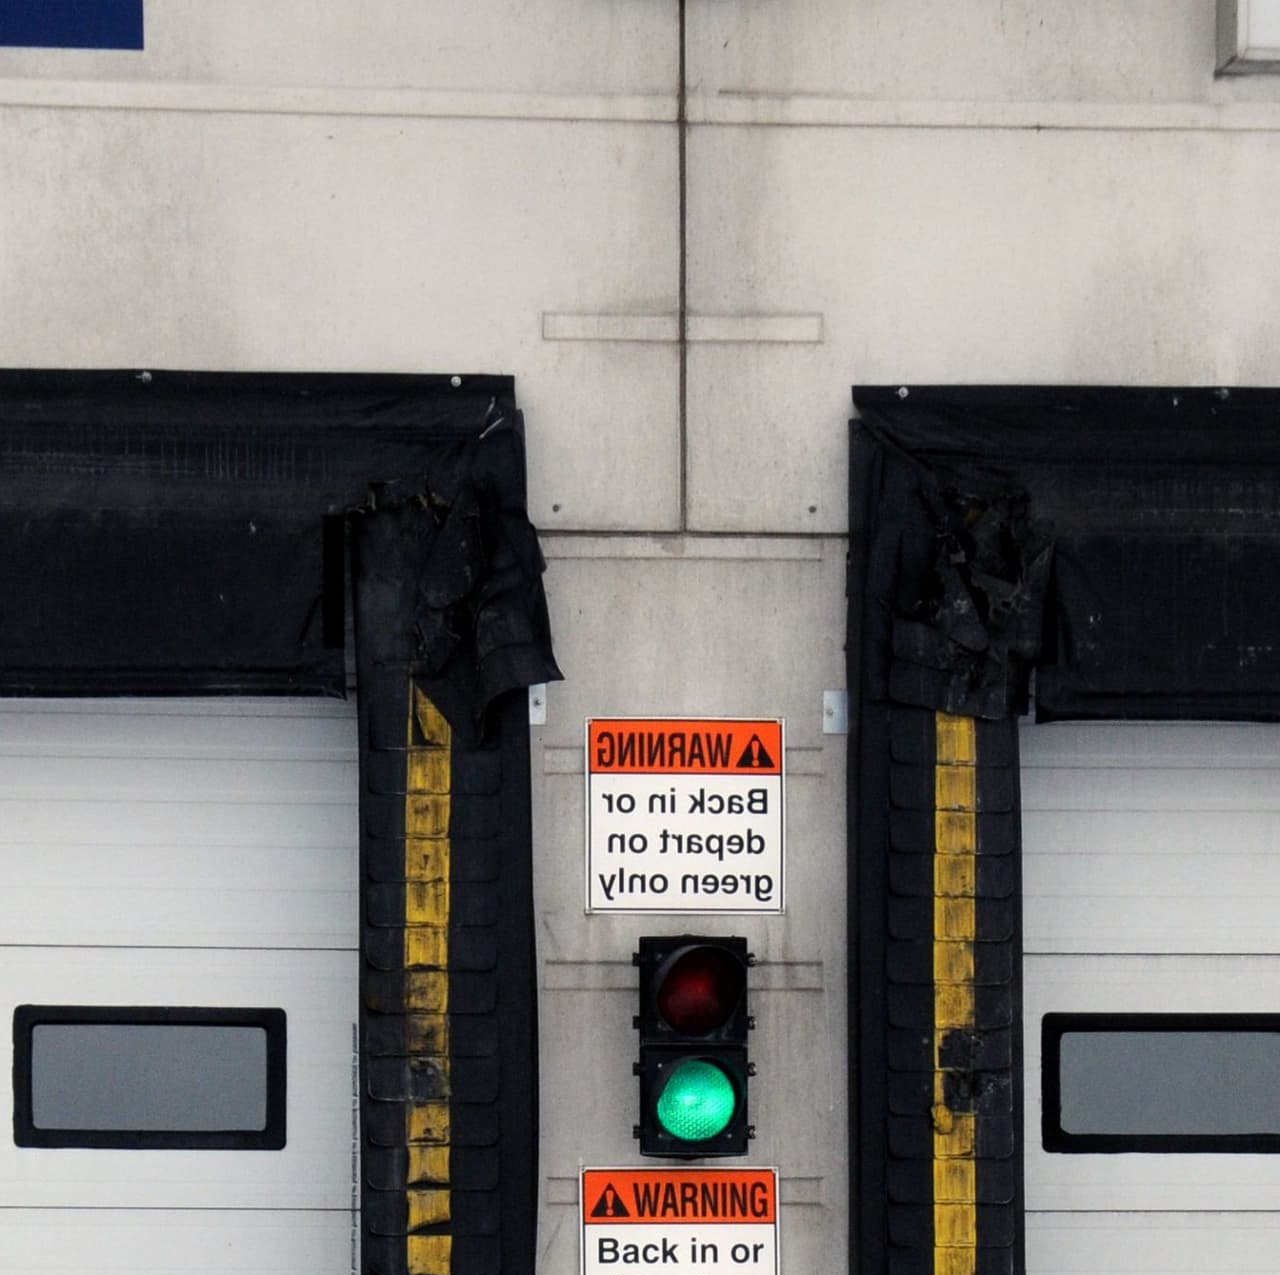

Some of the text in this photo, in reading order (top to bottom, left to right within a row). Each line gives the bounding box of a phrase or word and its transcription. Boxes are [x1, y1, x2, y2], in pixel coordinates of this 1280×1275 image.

[632, 1181, 769, 1218] WARNING
[598, 1237, 765, 1264] Back in or
